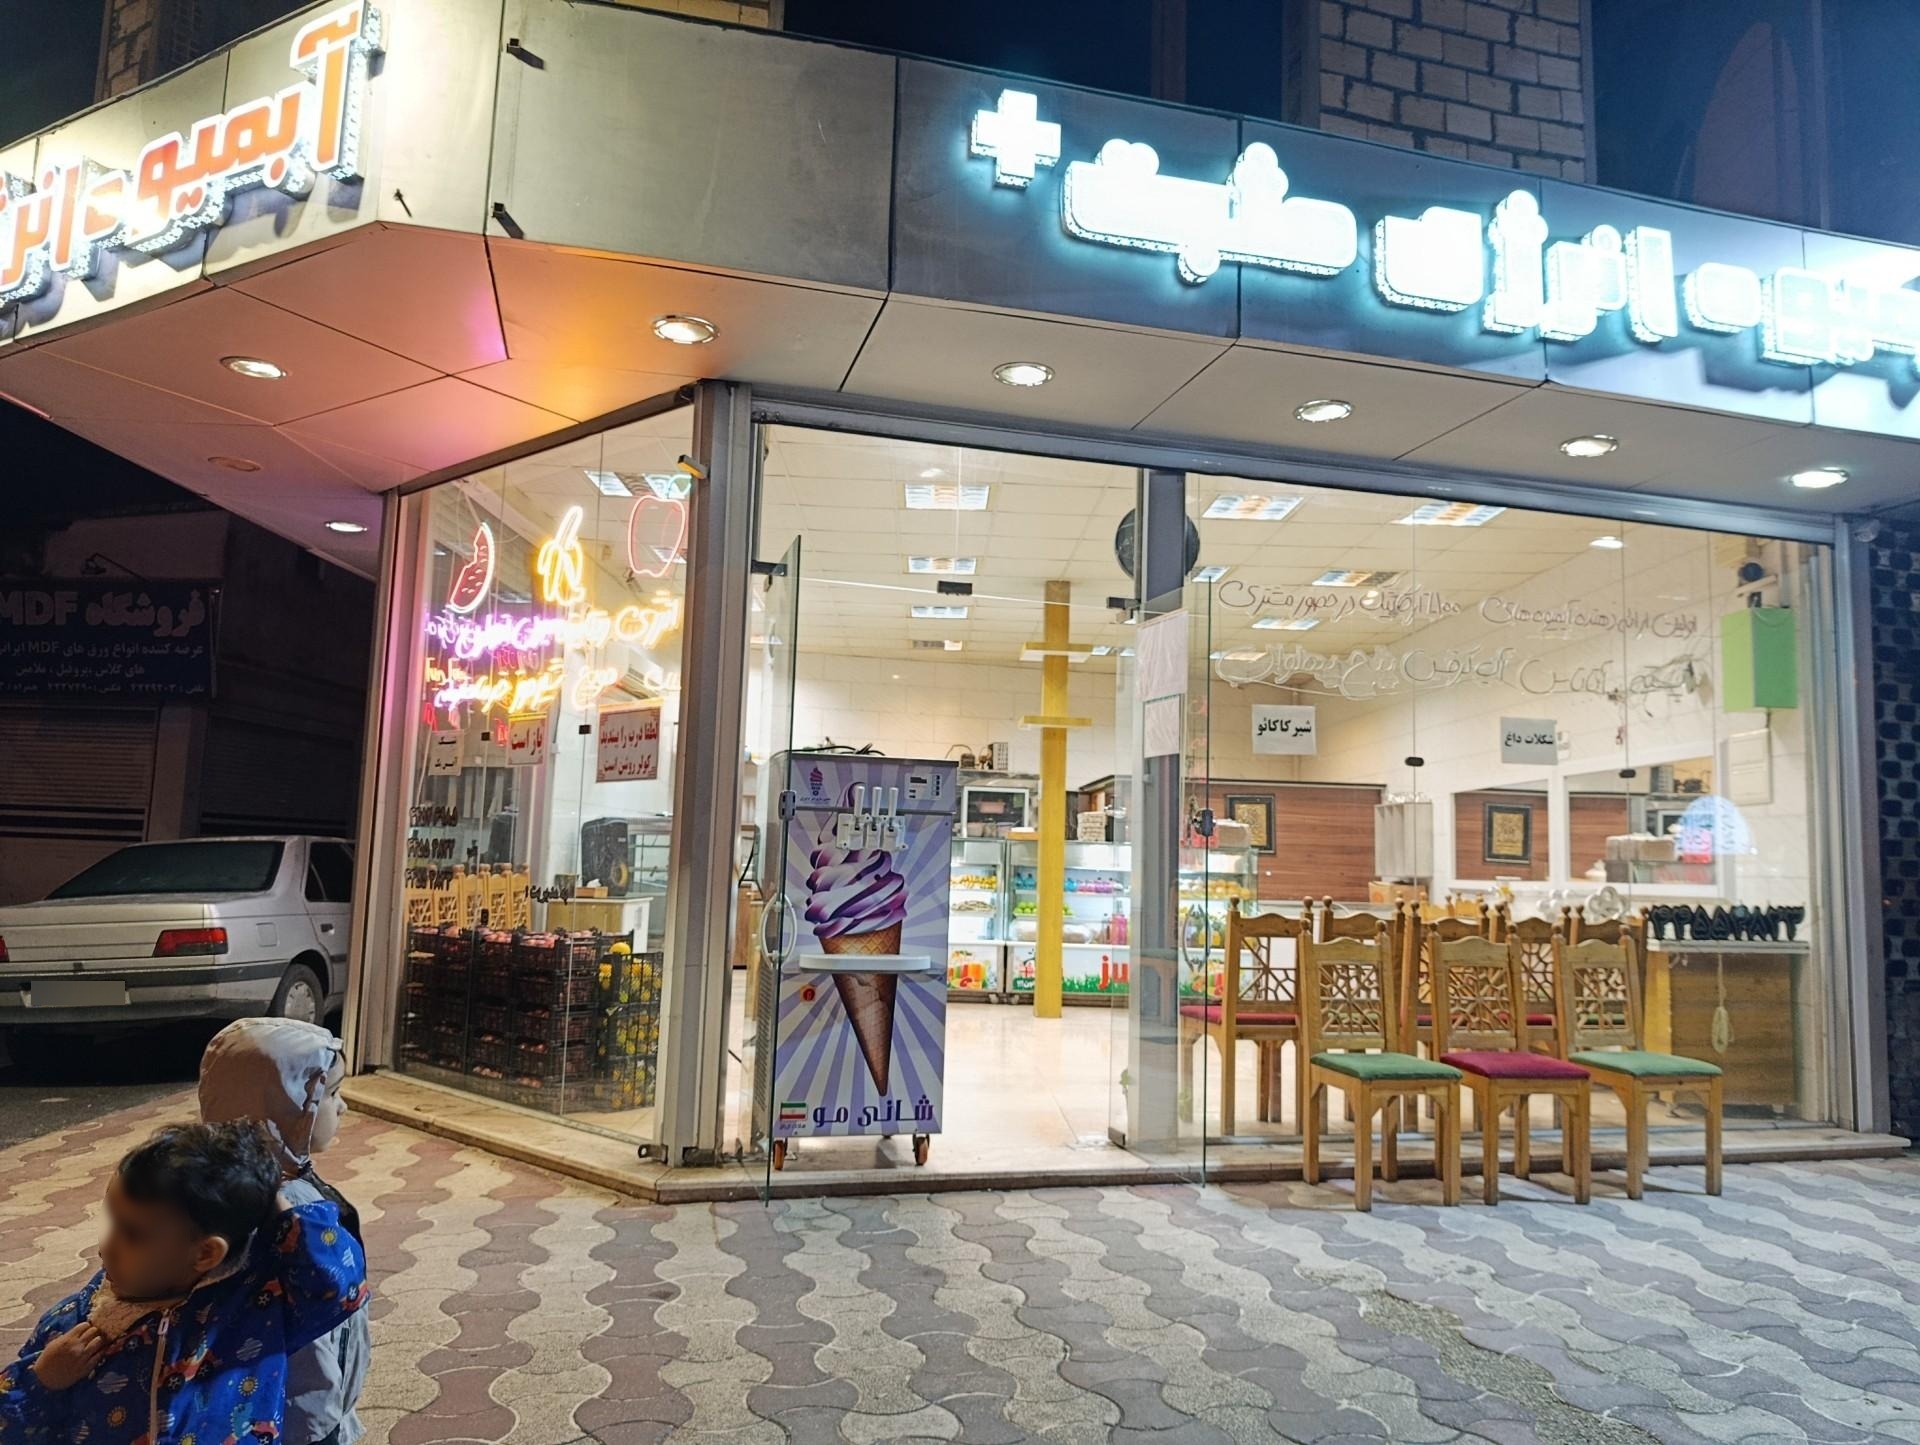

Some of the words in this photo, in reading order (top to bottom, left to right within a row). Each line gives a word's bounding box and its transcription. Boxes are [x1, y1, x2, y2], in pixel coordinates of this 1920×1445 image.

[80, 0, 366, 245] آبمیوه
[85, 588, 206, 637] فروشگاه
[1257, 717, 1291, 736] کاکائو
[1292, 720, 1312, 737] شیر
[1504, 731, 1522, 747] داغ
[812, 1105, 849, 1128] مو
[858, 1094, 934, 1127] شانی
